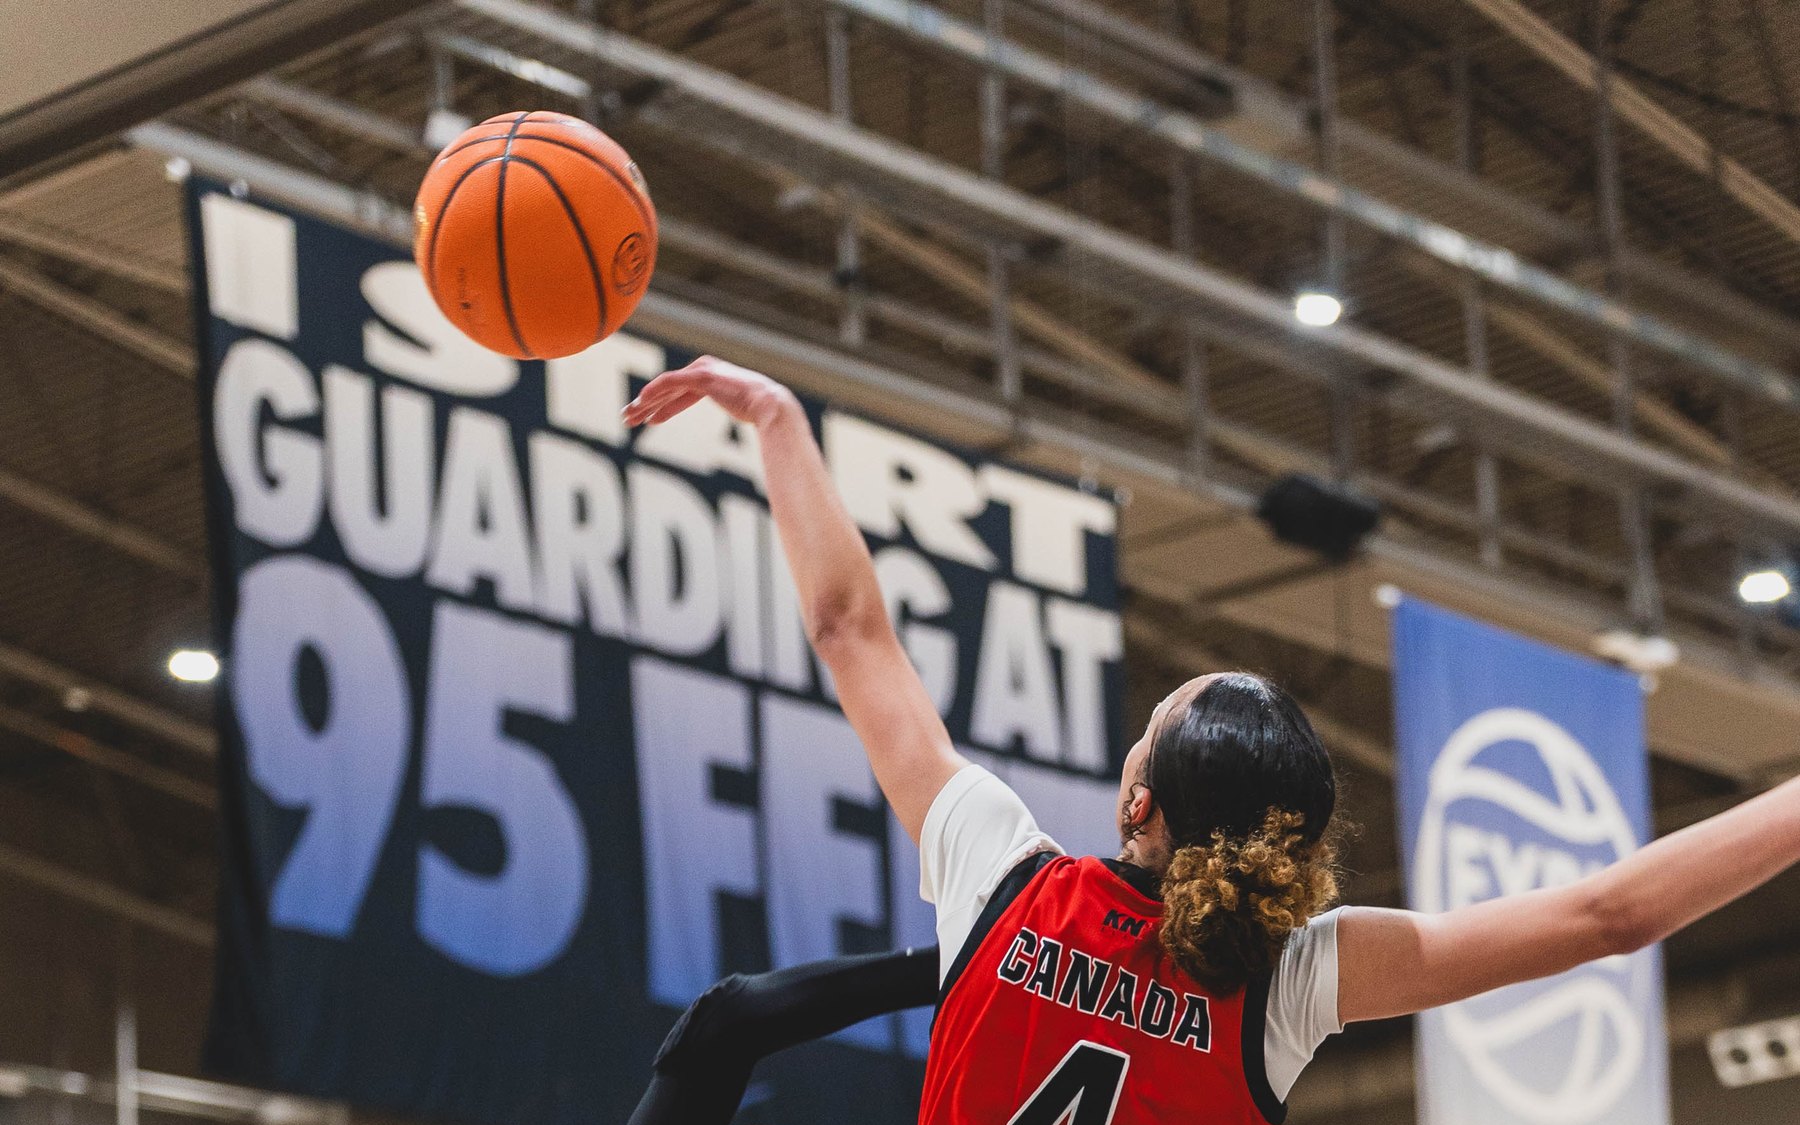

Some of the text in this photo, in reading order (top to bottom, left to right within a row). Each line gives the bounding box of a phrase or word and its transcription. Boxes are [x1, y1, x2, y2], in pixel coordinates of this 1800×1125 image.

[201, 195, 297, 340] I
[968, 580, 1123, 773] AT
[230, 553, 590, 978] 95
[997, 926, 1211, 1053] CANADA
[1103, 908, 1147, 938] KN
